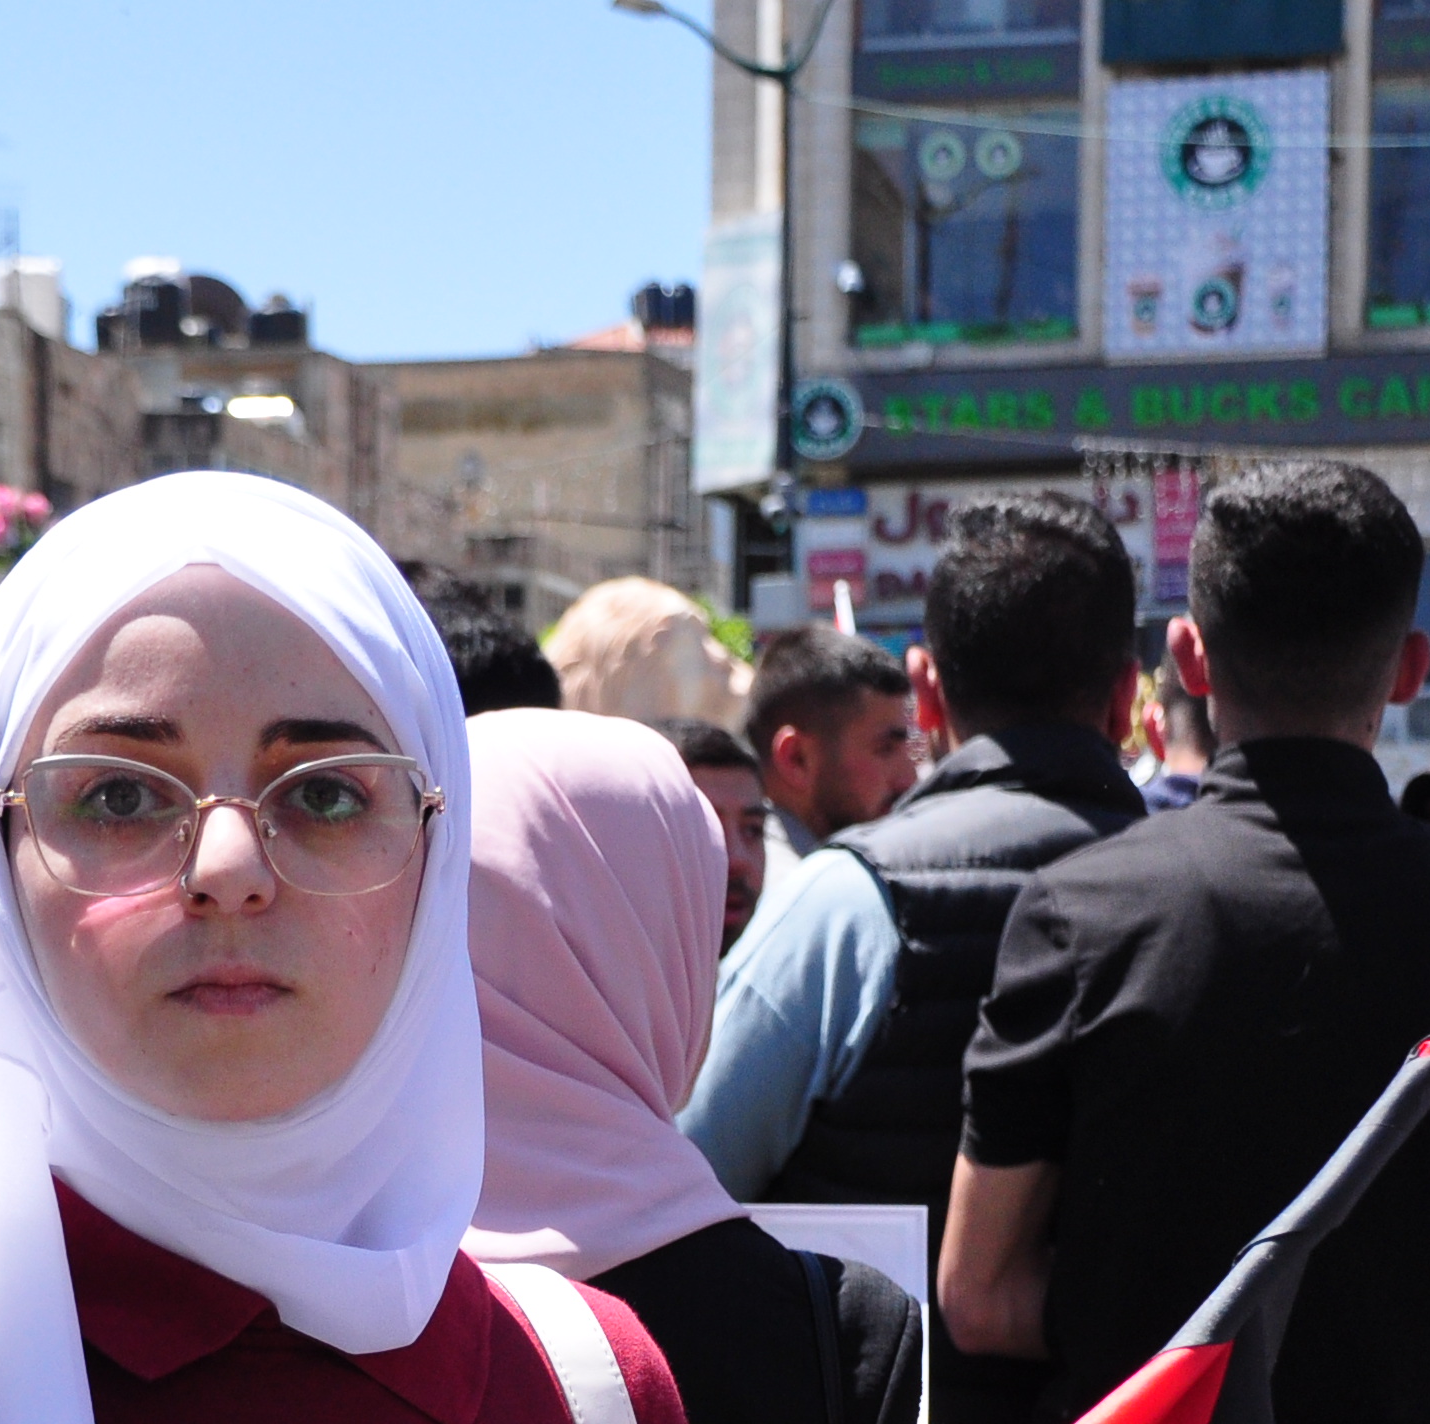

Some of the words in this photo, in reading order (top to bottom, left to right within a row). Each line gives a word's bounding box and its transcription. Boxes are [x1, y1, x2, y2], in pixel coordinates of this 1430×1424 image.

[884, 390, 1056, 437] STARS
[1074, 387, 1112, 430] &
[1130, 381, 1320, 428] BUCKS
